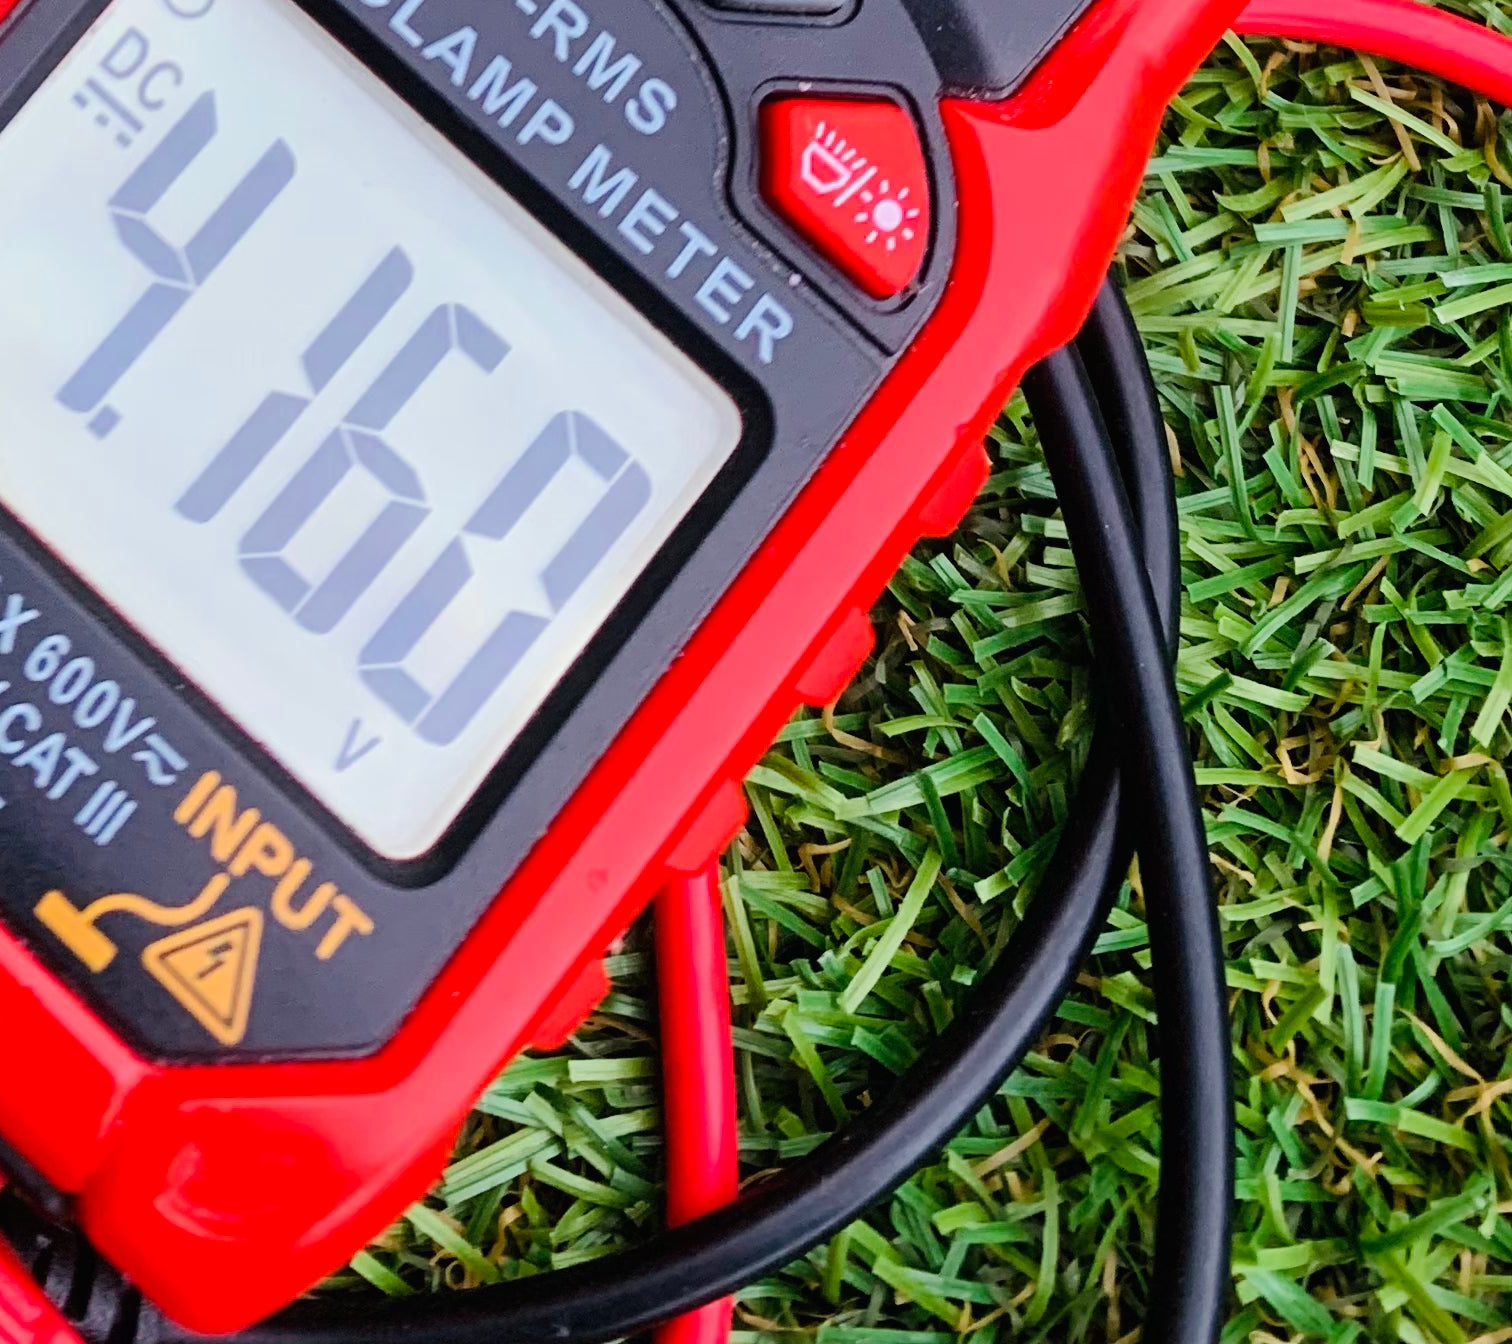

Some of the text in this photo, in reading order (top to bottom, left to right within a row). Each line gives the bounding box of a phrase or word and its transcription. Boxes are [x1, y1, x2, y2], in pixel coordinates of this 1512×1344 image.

[98, 26, 185, 110] DC
[567, 143, 795, 365] METER
[54, 89, 653, 748] 4.160
[76, 780, 138, 846] III
[335, 717, 385, 775] V
[173, 771, 375, 960] INPUT
